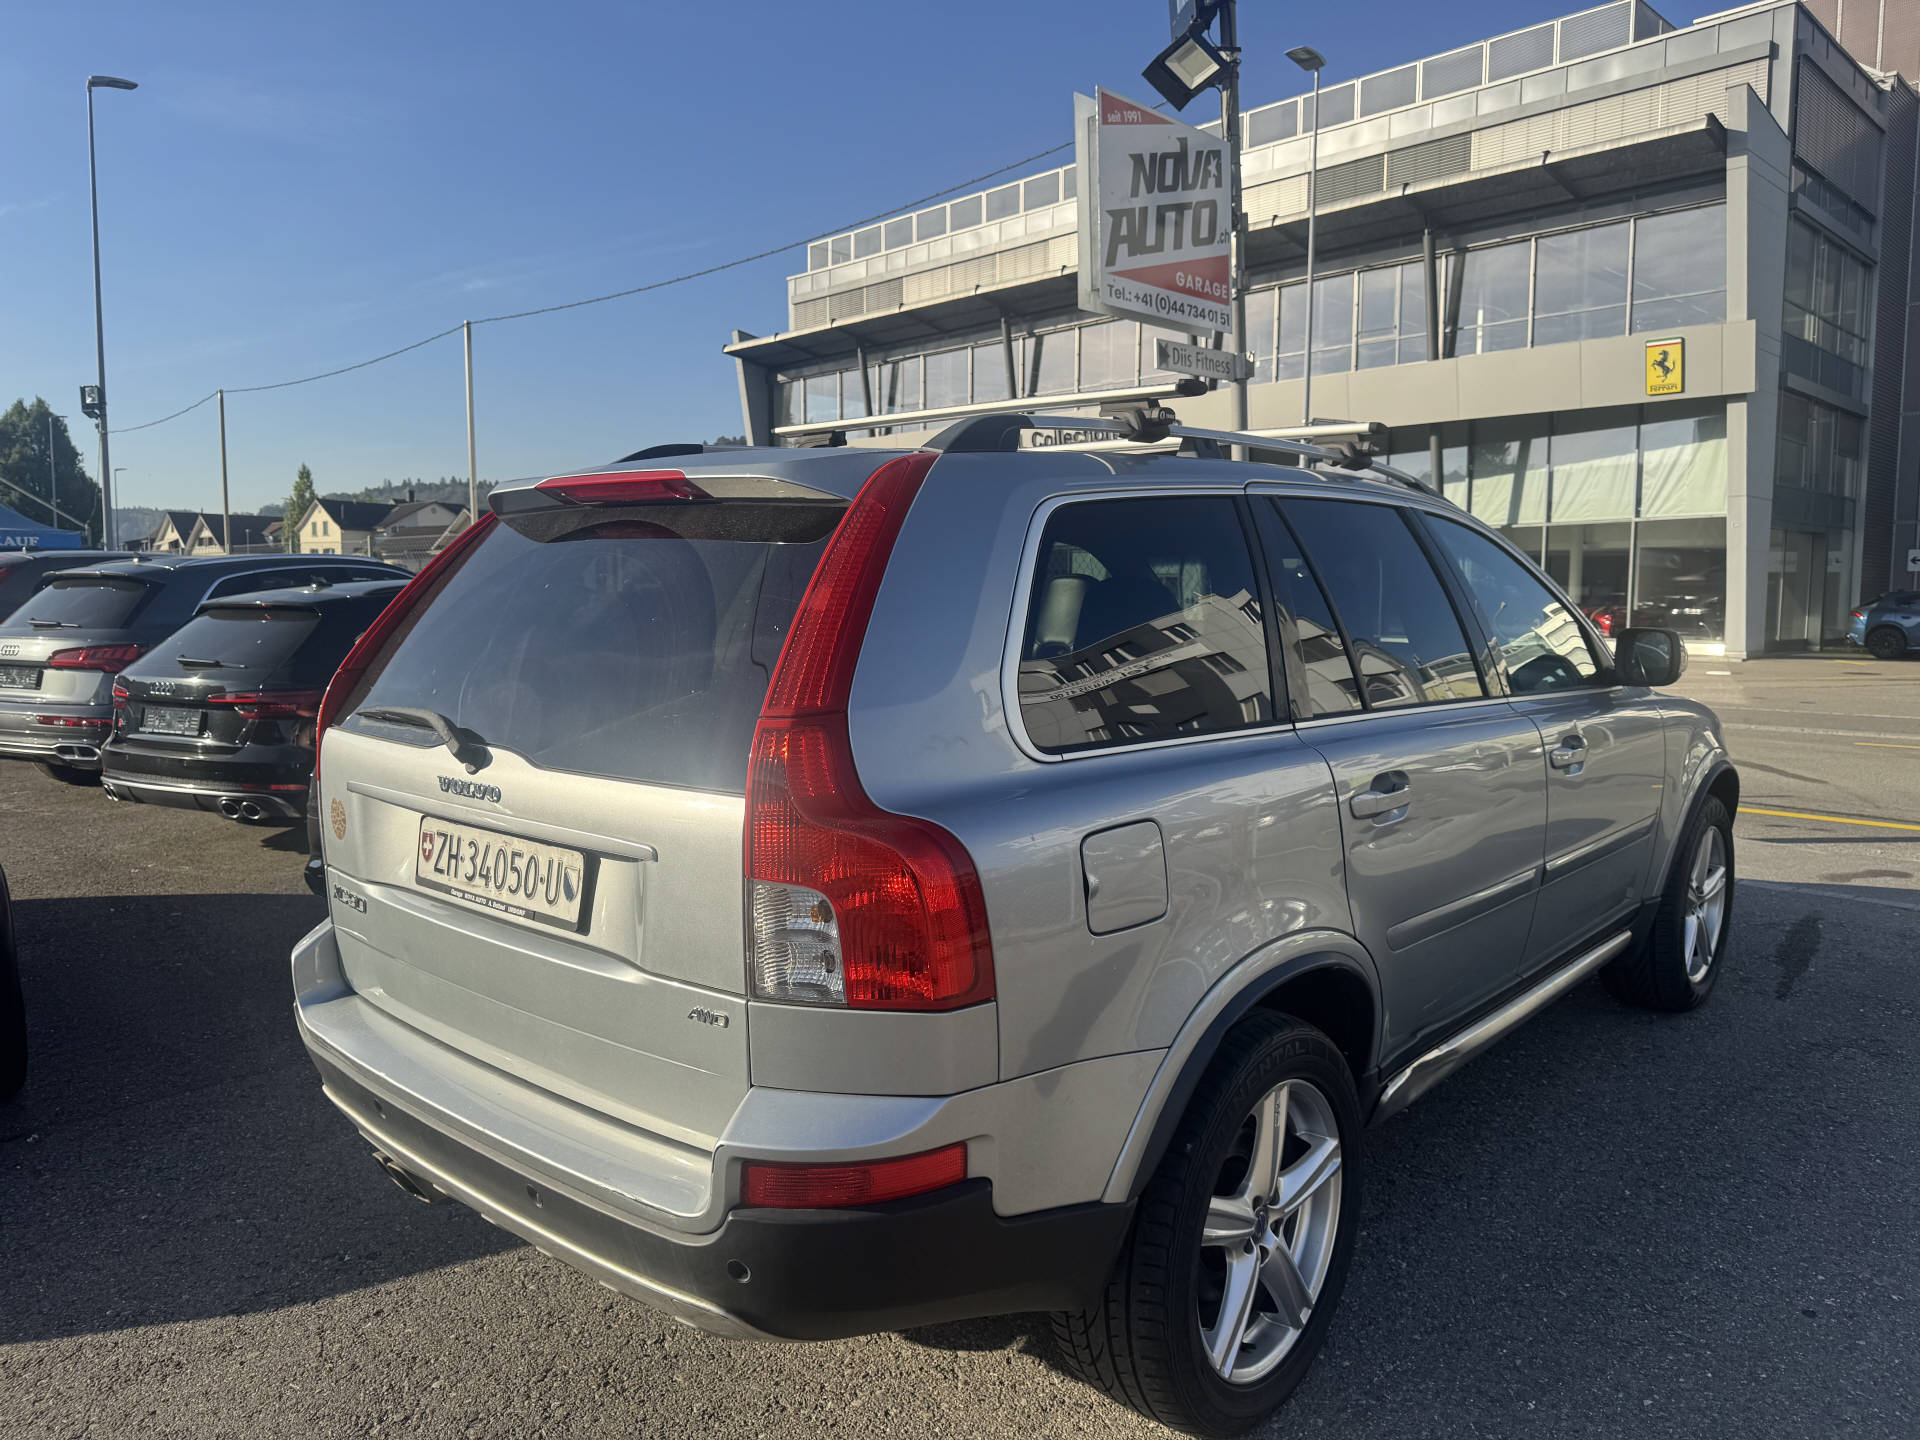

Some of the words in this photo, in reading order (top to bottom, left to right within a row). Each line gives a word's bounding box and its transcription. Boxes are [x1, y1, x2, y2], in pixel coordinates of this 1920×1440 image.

[1107, 110, 1121, 123] seit
[1123, 111, 1142, 123] 1991
[1128, 137, 1222, 198] NOVA
[1175, 272, 1229, 299] GARAGE
[1107, 284, 1132, 302] Tel.:
[1134, 292, 1152, 308] +41
[1187, 303, 1206, 320] 734
[1207, 309, 1218, 324] 01
[1220, 312, 1230, 326] 51
[1172, 347, 1192, 368] Diis
[1196, 352, 1231, 374] Fitness
[0, 536, 39, 546] AUF
[437, 775, 502, 804] VOLVO
[687, 1007, 730, 1029] AWD
